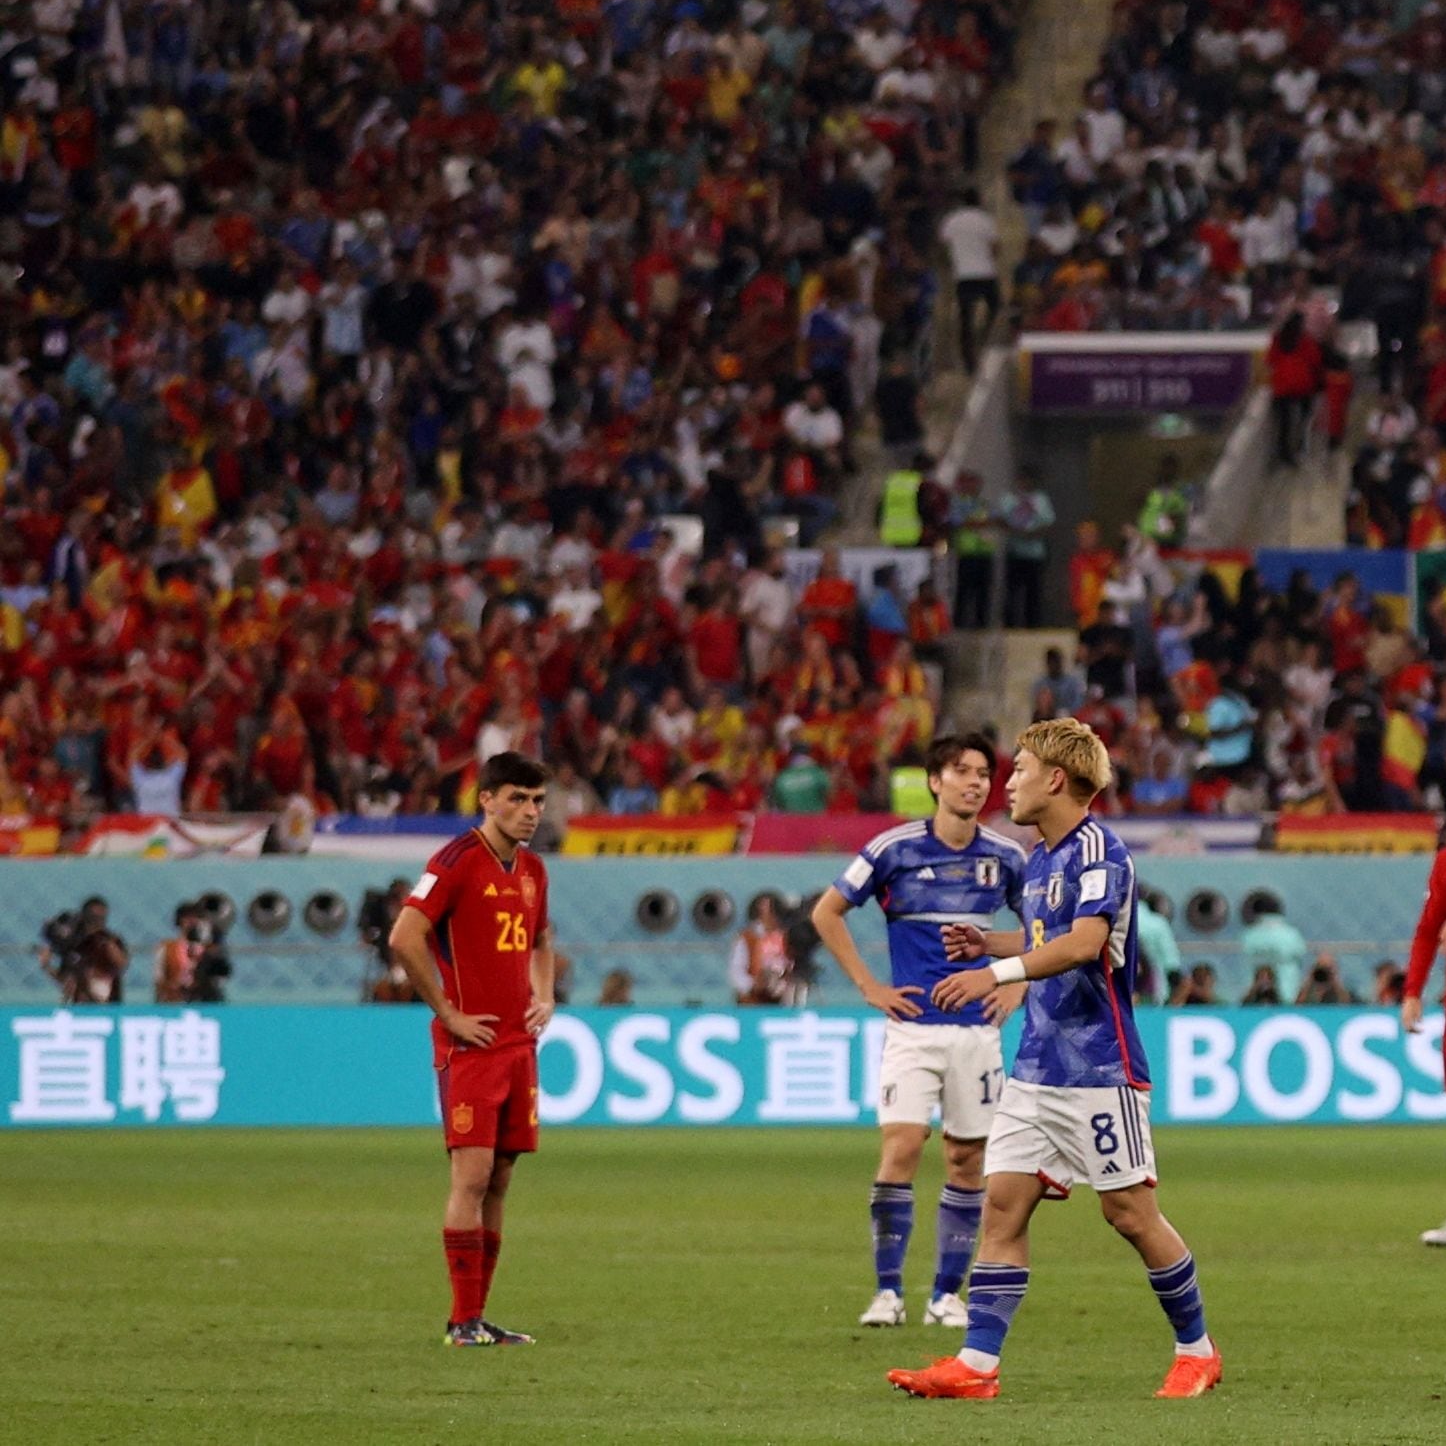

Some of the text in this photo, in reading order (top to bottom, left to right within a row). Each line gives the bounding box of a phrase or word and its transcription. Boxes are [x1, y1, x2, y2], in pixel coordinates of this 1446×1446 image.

[497, 911, 528, 951] 26
[10, 1010, 225, 1122] 直聘
[536, 1015, 742, 1124] OSS
[1091, 1112, 1119, 1155] 8
